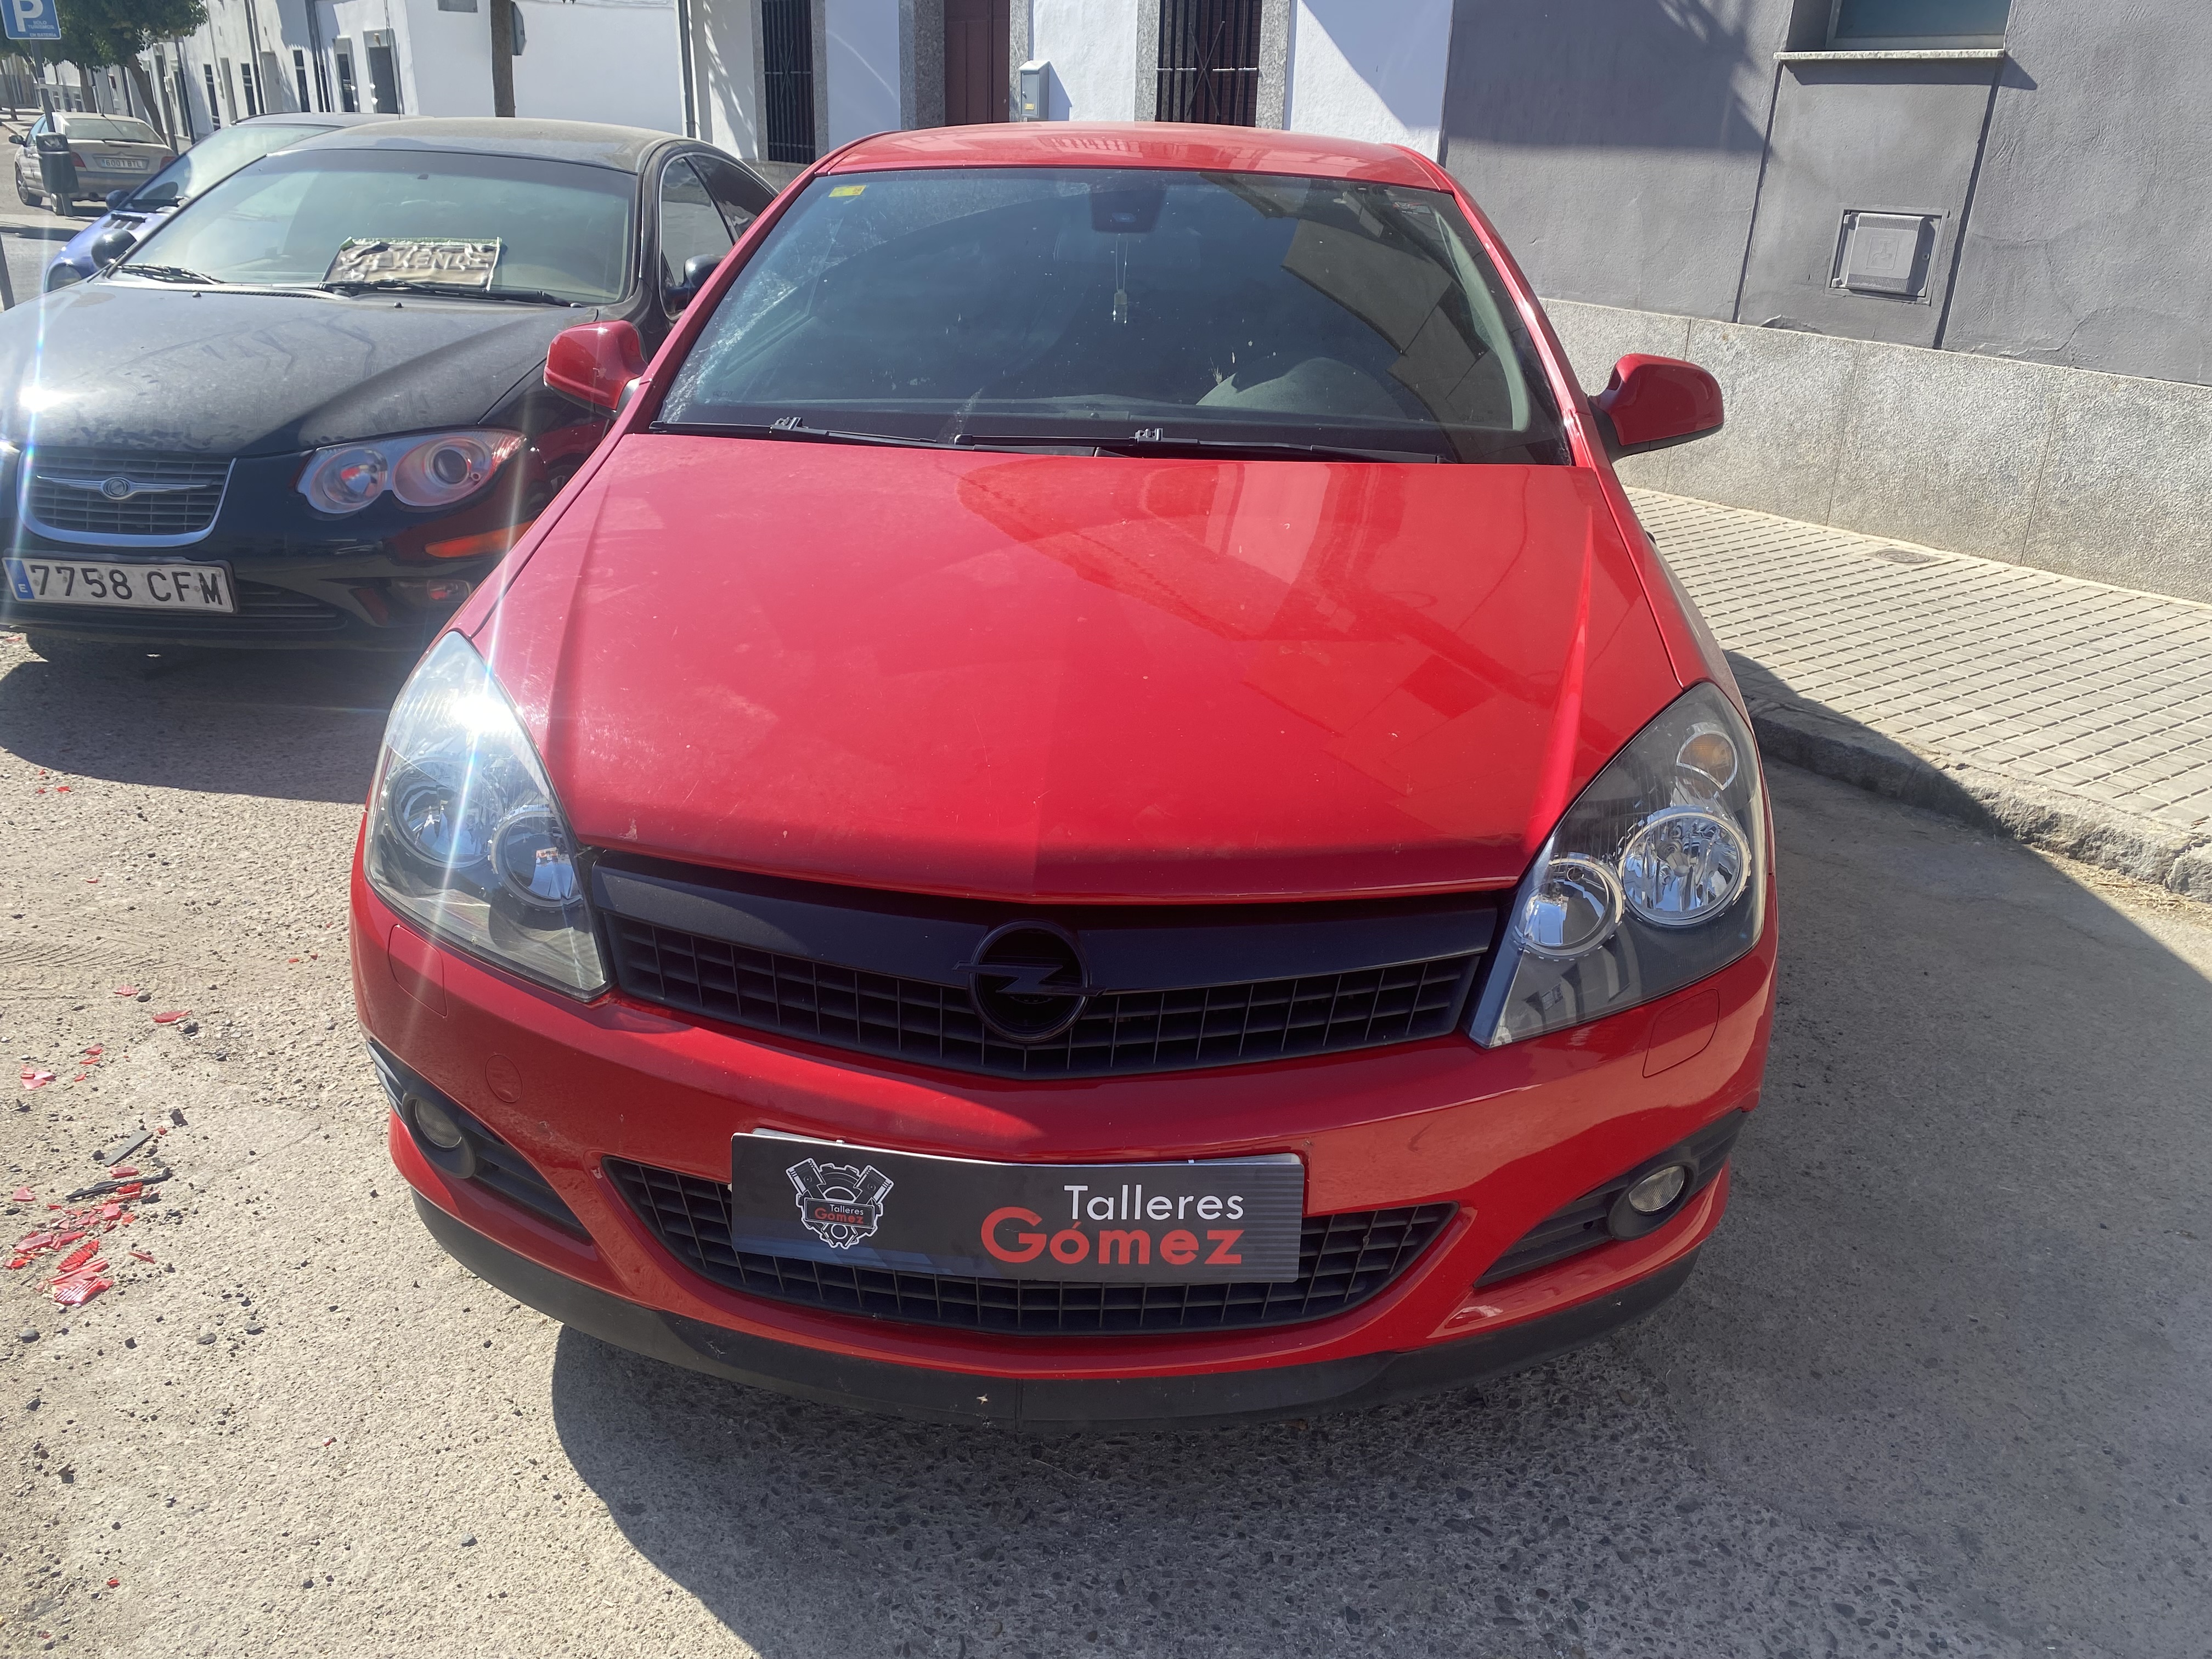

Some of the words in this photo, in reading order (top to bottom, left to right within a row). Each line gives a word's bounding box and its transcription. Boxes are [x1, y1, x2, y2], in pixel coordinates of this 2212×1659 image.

[12, 0, 43, 32] P
[18, 584, 28, 593] E
[29, 565, 133, 600] 7758
[147, 571, 223, 606] CFM
[830, 1204, 864, 1216] Talleres
[1064, 1184, 1244, 1220] Talleres
[981, 1206, 1245, 1265] Gómez
